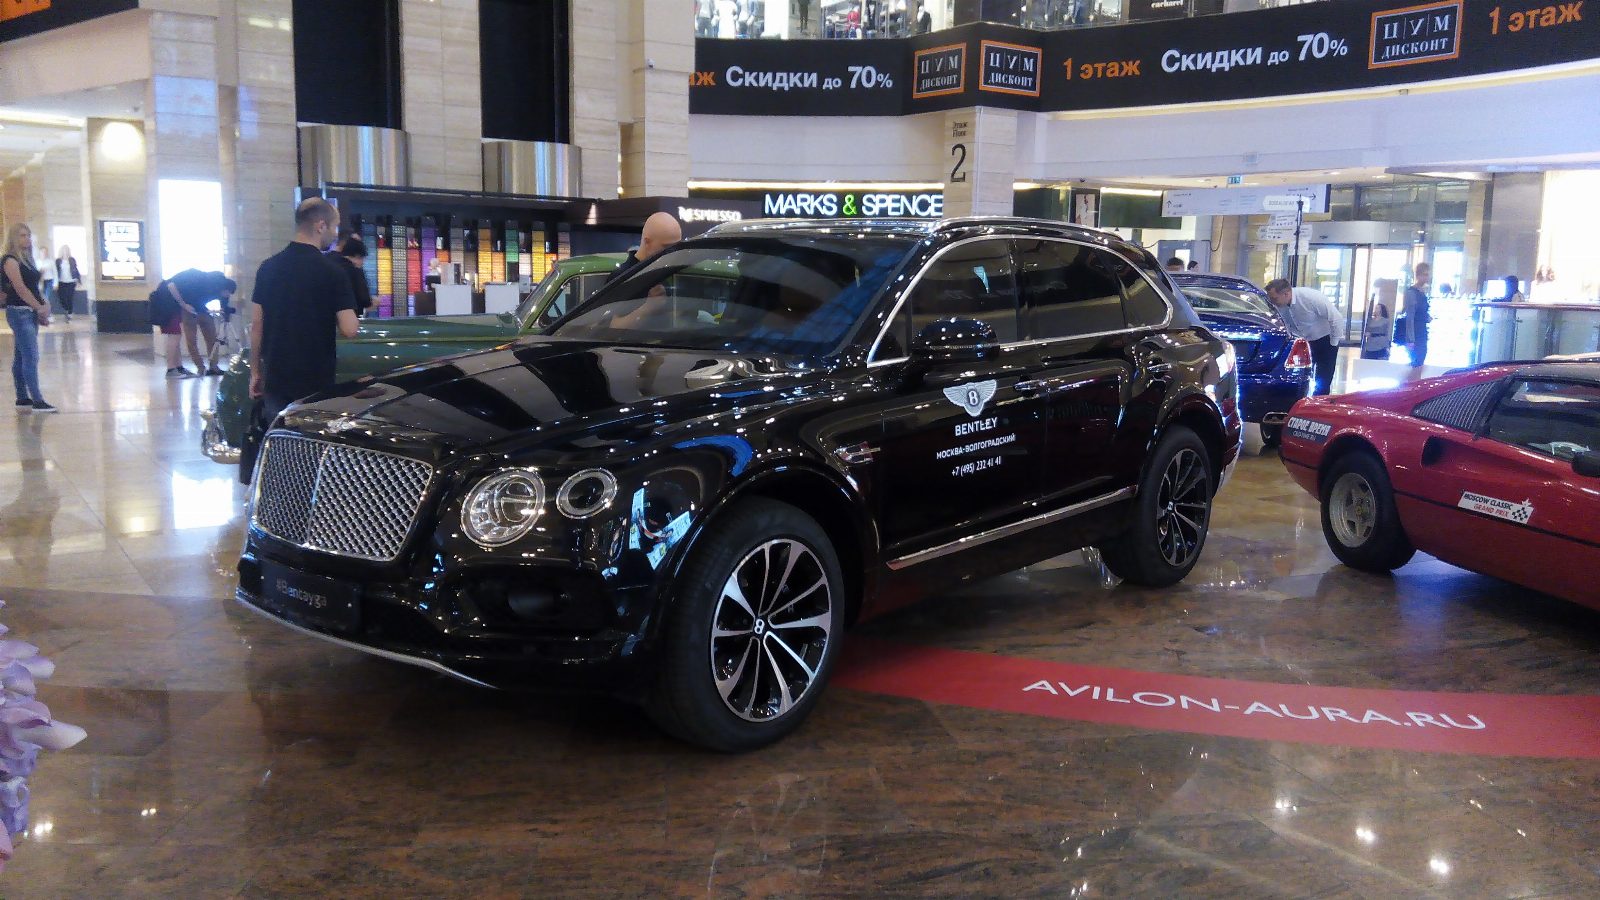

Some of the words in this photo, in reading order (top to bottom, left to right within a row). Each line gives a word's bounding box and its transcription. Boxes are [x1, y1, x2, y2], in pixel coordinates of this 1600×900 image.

[1383, 15, 1450, 40] ЦУМ
[1489, 7, 1500, 35] 1
[1508, 2, 1583, 32] этаж
[1160, 43, 1263, 73] Скидки
[1267, 50, 1290, 66] до
[1297, 32, 1349, 61] 70%
[726, 66, 817, 90] Скидки
[823, 77, 842, 89] до
[848, 66, 893, 88] 70%
[1062, 58, 1073, 80] 1
[1080, 60, 1141, 79] этаж
[951, 144, 966, 182] 2
[765, 193, 838, 216] MARKS
[842, 195, 857, 215] &
[955, 417, 998, 436] BENTLEY
[936, 433, 1016, 460] МОСКВА-ВОЛГОГРАДСКИЙ
[960, 462, 975, 477] (495)
[976, 459, 987, 471] 232
[987, 457, 994, 468] 41
[995, 455, 1002, 465] 41
[1464, 493, 1490, 505] MOSCOW
[1490, 500, 1513, 511] CLASSIC
[1473, 503, 1495, 513] GRAND
[1495, 509, 1510, 517] PRIX
[1022, 679, 1486, 730] AVILON-AURA.RU
